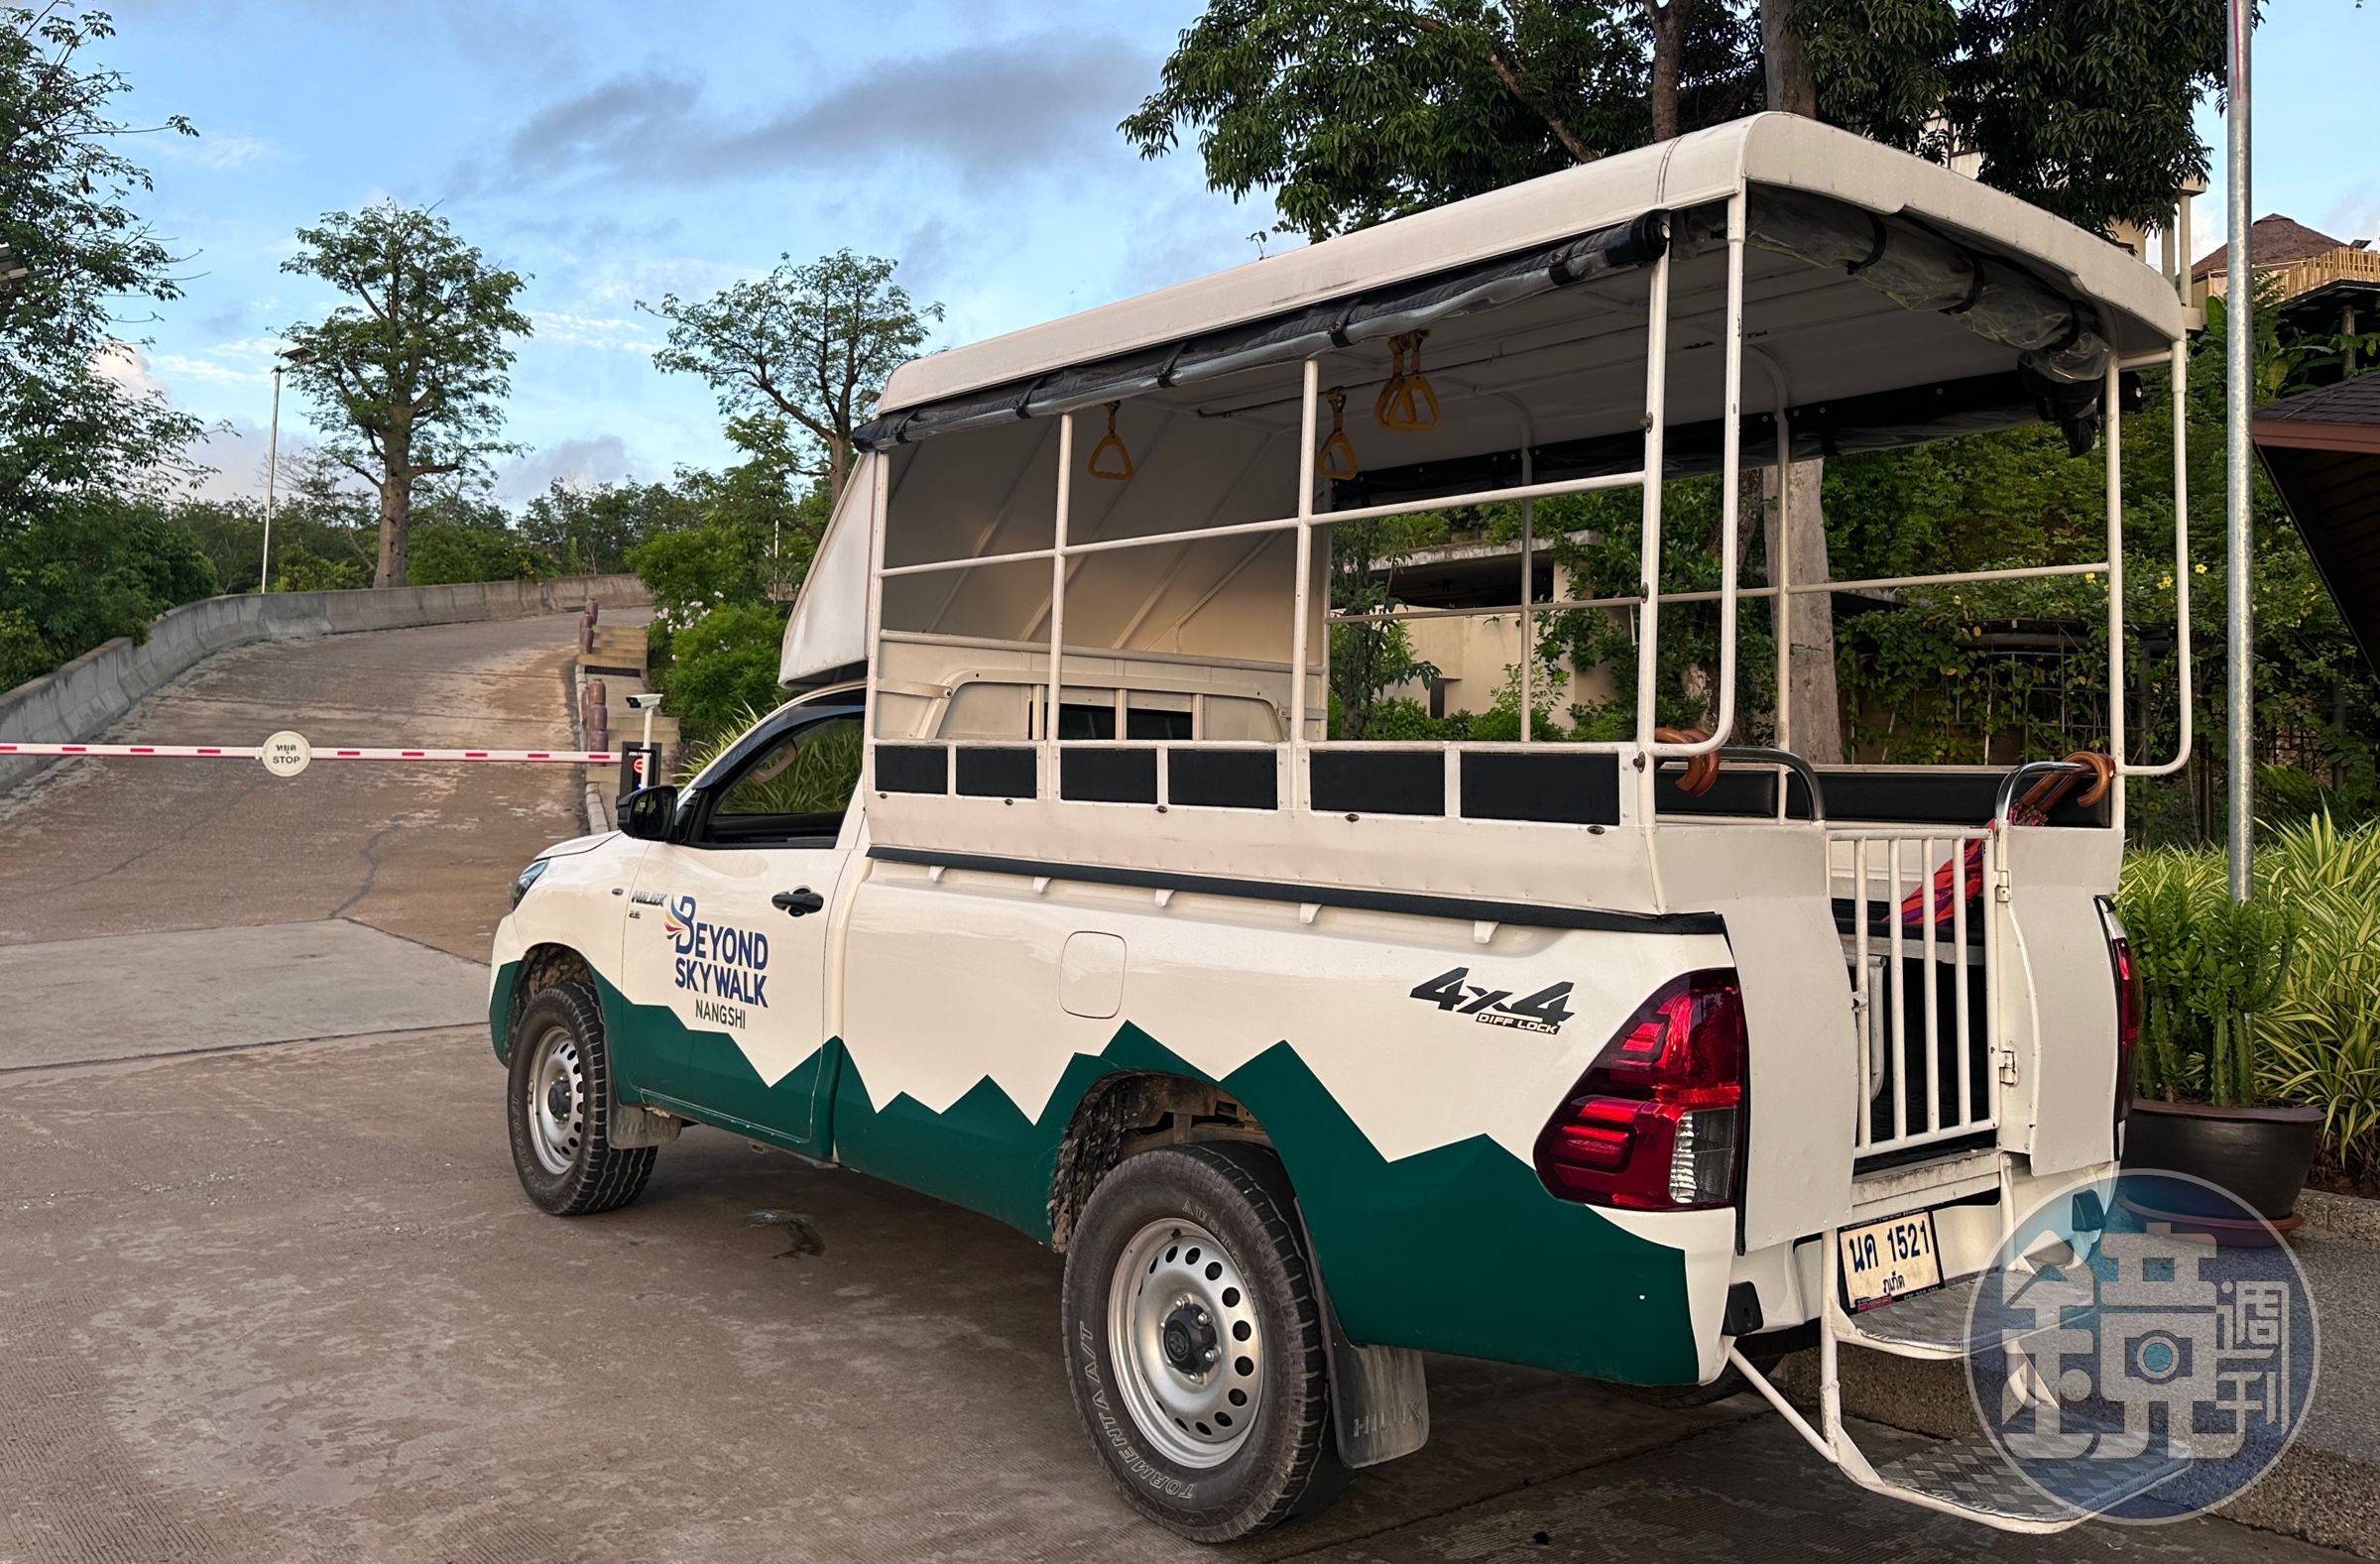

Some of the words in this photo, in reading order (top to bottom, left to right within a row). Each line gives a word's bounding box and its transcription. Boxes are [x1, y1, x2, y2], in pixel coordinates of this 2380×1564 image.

[667, 895, 769, 971] BEYOND
[675, 957, 769, 1008] SKYWALK
[696, 999, 746, 1028] NANGSHI
[1478, 1014, 1514, 1026] DIFF
[1516, 1020, 1558, 1034] LOCK
[1887, 1220, 1930, 1262] 1521
[1080, 1320, 1101, 1384] A/T
[1092, 1389, 1195, 1499] TORMENTA
